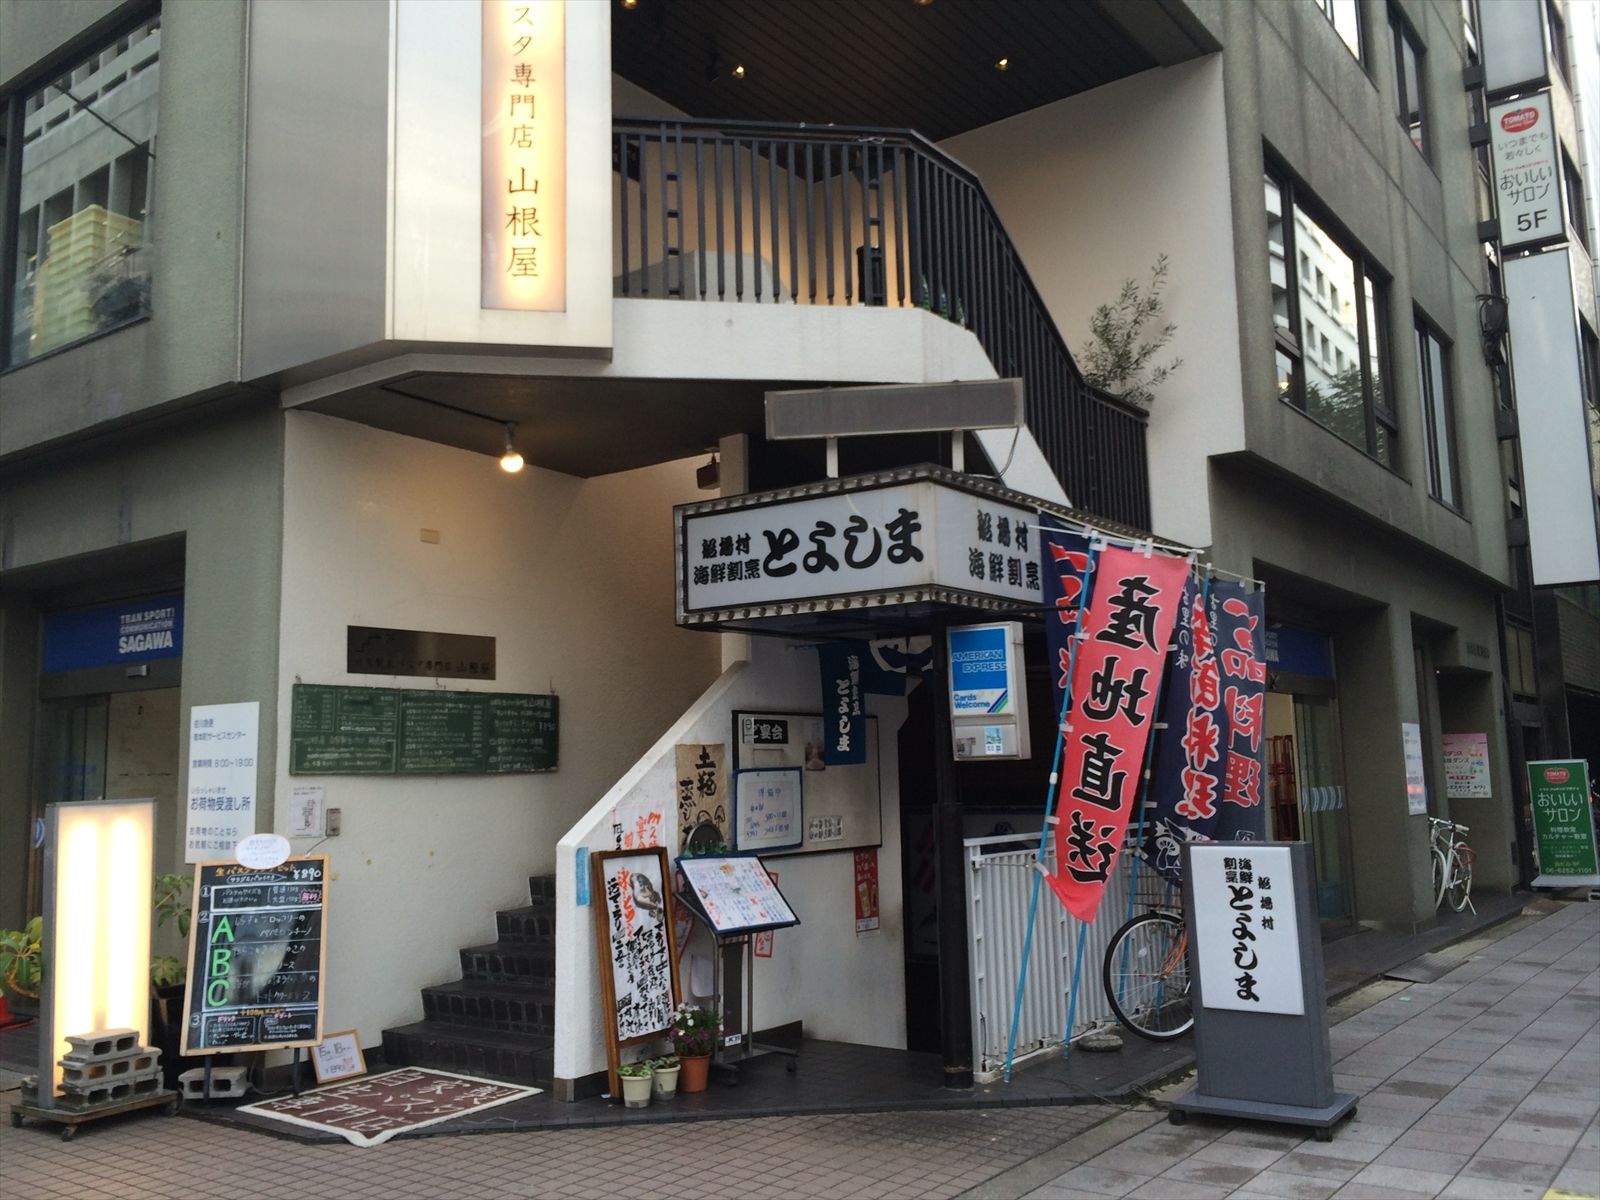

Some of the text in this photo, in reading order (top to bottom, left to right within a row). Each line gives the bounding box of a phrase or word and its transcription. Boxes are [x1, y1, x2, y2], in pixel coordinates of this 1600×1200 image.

[1498, 132, 1549, 150] いつまでも
[1500, 166, 1552, 191] おいしい
[1507, 184, 1549, 205] サロン
[505, 167, 542, 278] 山根屋
[1517, 209, 1547, 232] 5F
[762, 508, 924, 578] とよしま
[693, 558, 761, 586] 海鮮割烹
[968, 546, 1040, 591] 海鮮割烹
[119, 630, 174, 654] SAGAWA
[952, 650, 1003, 662] AMERICAN
[962, 662, 1007, 673] EXPRESS
[835, 678, 850, 752] とよしま
[954, 701, 991, 709] Welcome
[190, 796, 251, 811] お荷物受渡し所
[1537, 792, 1583, 807] おいしい
[1544, 808, 1581, 823] サロン
[211, 915, 235, 943] A
[1227, 884, 1260, 1002] とよしま
[211, 949, 231, 977] B
[207, 979, 230, 1007] C
